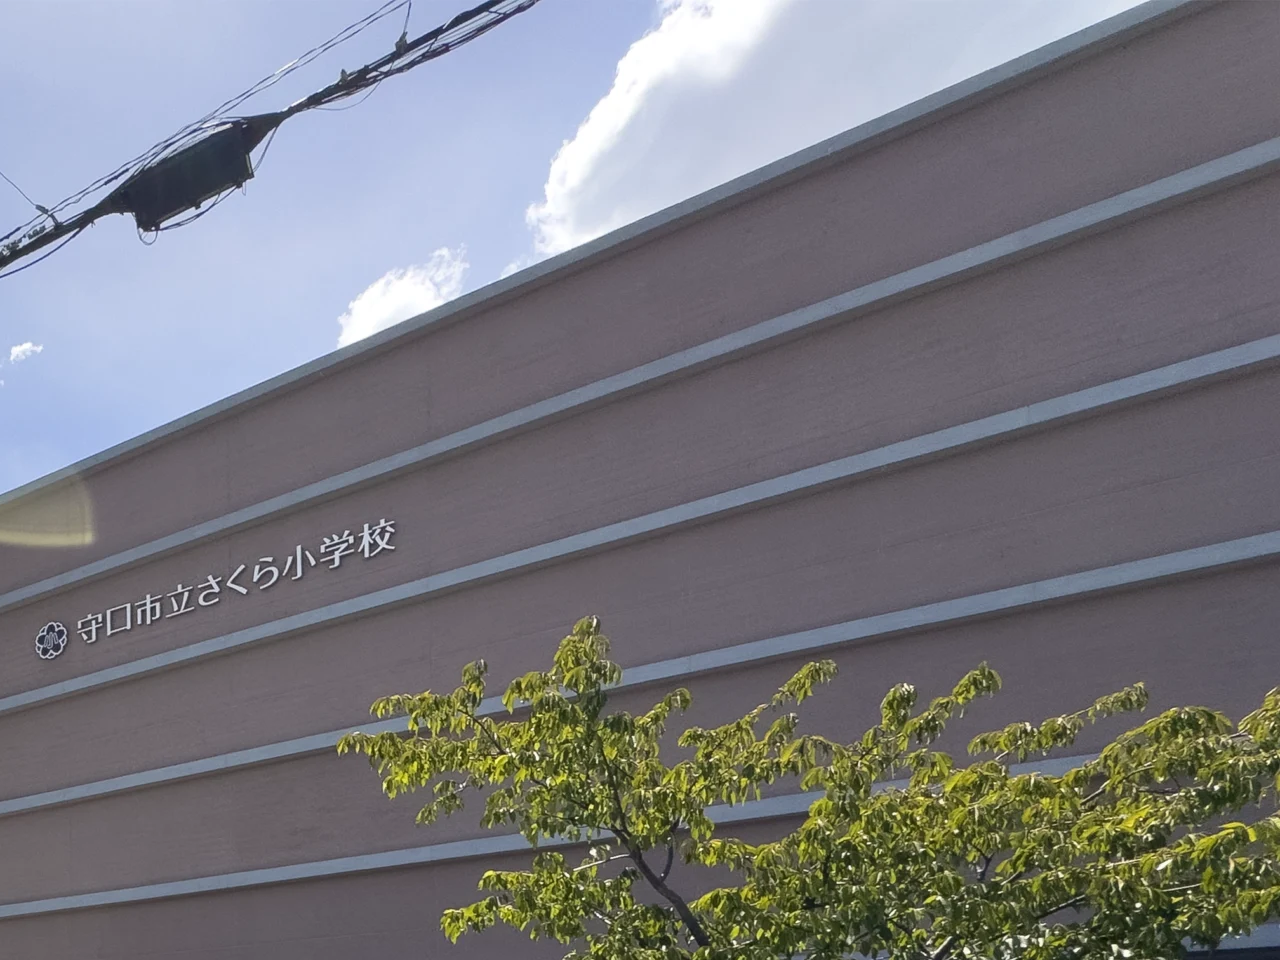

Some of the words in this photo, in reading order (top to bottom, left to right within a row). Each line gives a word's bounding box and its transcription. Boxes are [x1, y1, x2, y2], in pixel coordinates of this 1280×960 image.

[76, 518, 397, 644] 守口市立さくら小学校
